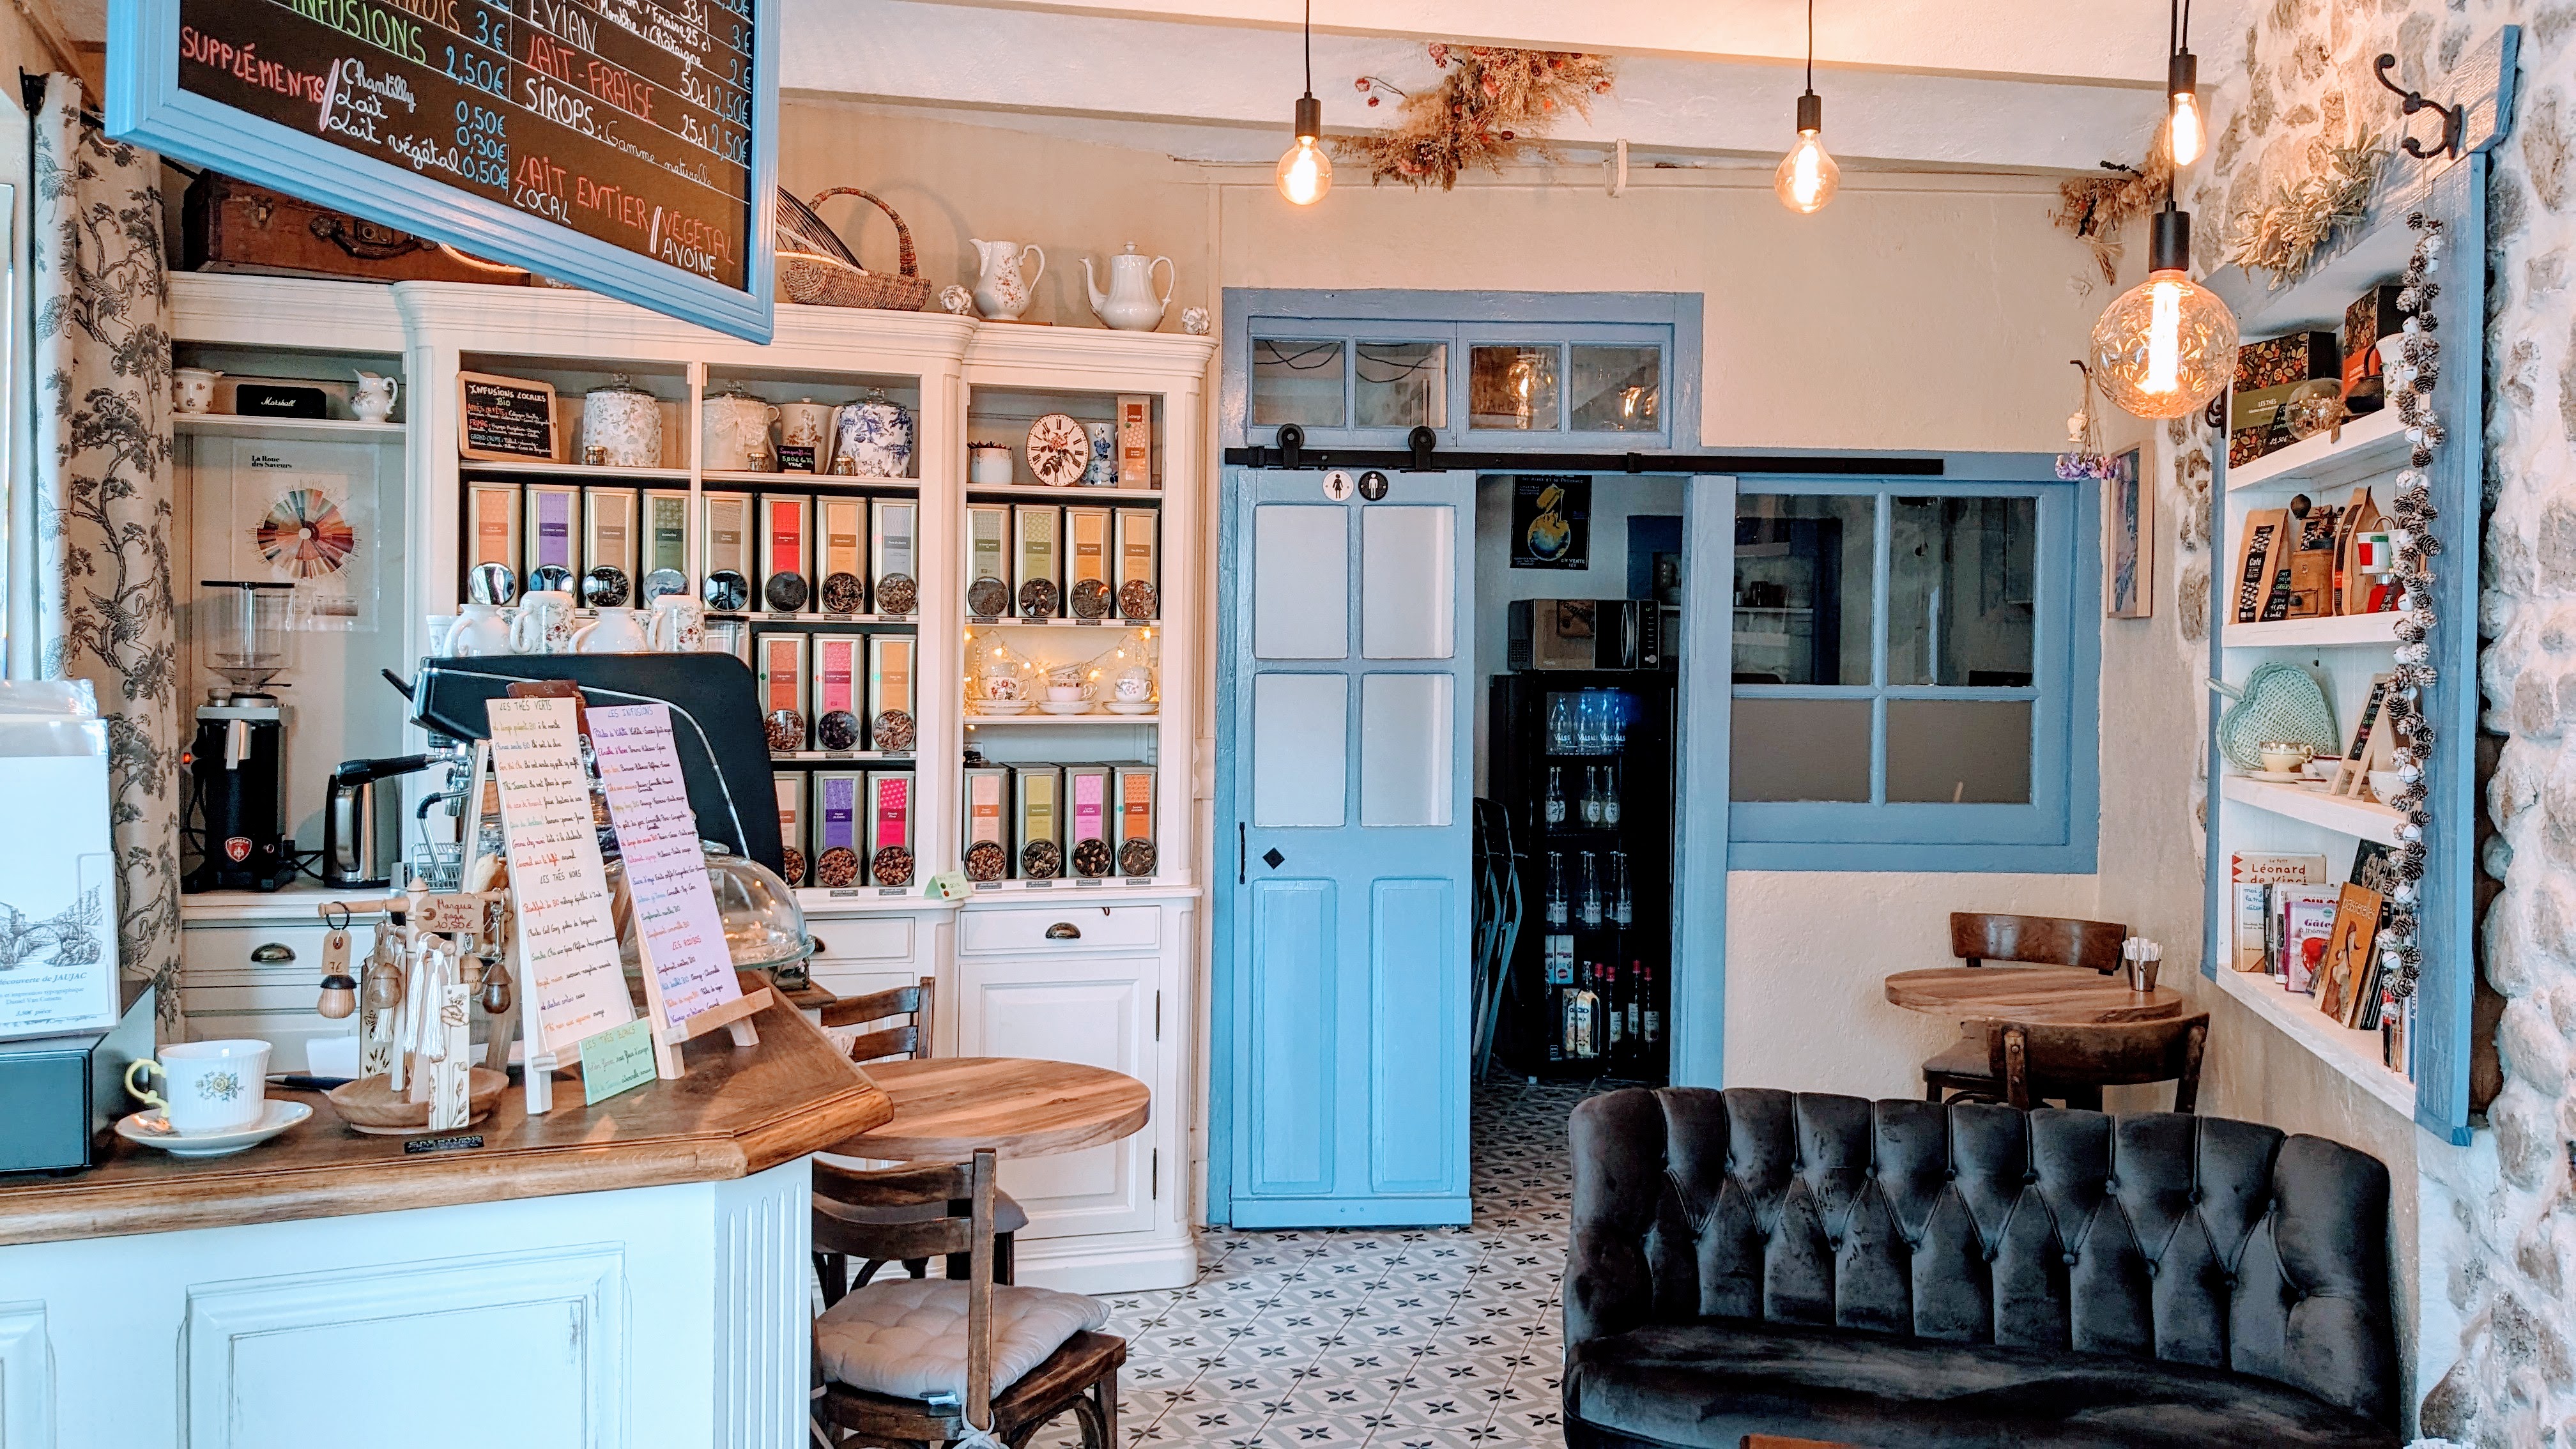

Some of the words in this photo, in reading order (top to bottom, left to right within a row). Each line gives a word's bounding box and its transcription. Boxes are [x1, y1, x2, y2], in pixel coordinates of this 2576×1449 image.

[181, 25, 325, 103] SUPPLÉMENTS
[445, 45, 508, 100] 2,50€
[342, 57, 417, 114] Chantilly
[456, 100, 507, 138] 0,50€
[588, 61, 657, 125] FRAISE
[711, 123, 749, 166] 2,50€
[714, 86, 750, 128] 2,50€
[335, 85, 388, 119] Lait
[456, 125, 507, 164] 0,30€
[328, 111, 382, 144] Lait
[387, 134, 464, 176] végétal
[462, 155, 509, 190] 0,50€
[512, 184, 572, 225] LOCAL
[261, 396, 296, 407] Marshall
[468, 384, 515, 398] INFUSIONS
[516, 392, 547, 402] LOCALES
[2249, 557, 2262, 567] Café
[500, 702, 511, 711] LES
[514, 700, 530, 711] THÉS
[533, 699, 553, 711] VERTS
[608, 709, 619, 718] LES
[622, 705, 654, 716] INFUSIONS
[540, 874, 550, 884] LES
[552, 868, 565, 882] THÉS
[2251, 863, 2306, 875] Léonard
[2250, 875, 2266, 884] de
[437, 898, 475, 914] Marque
[52, 972, 88, 983] JAUJAC
[586, 1039, 597, 1050] LES
[599, 1032, 614, 1044] THÉS
